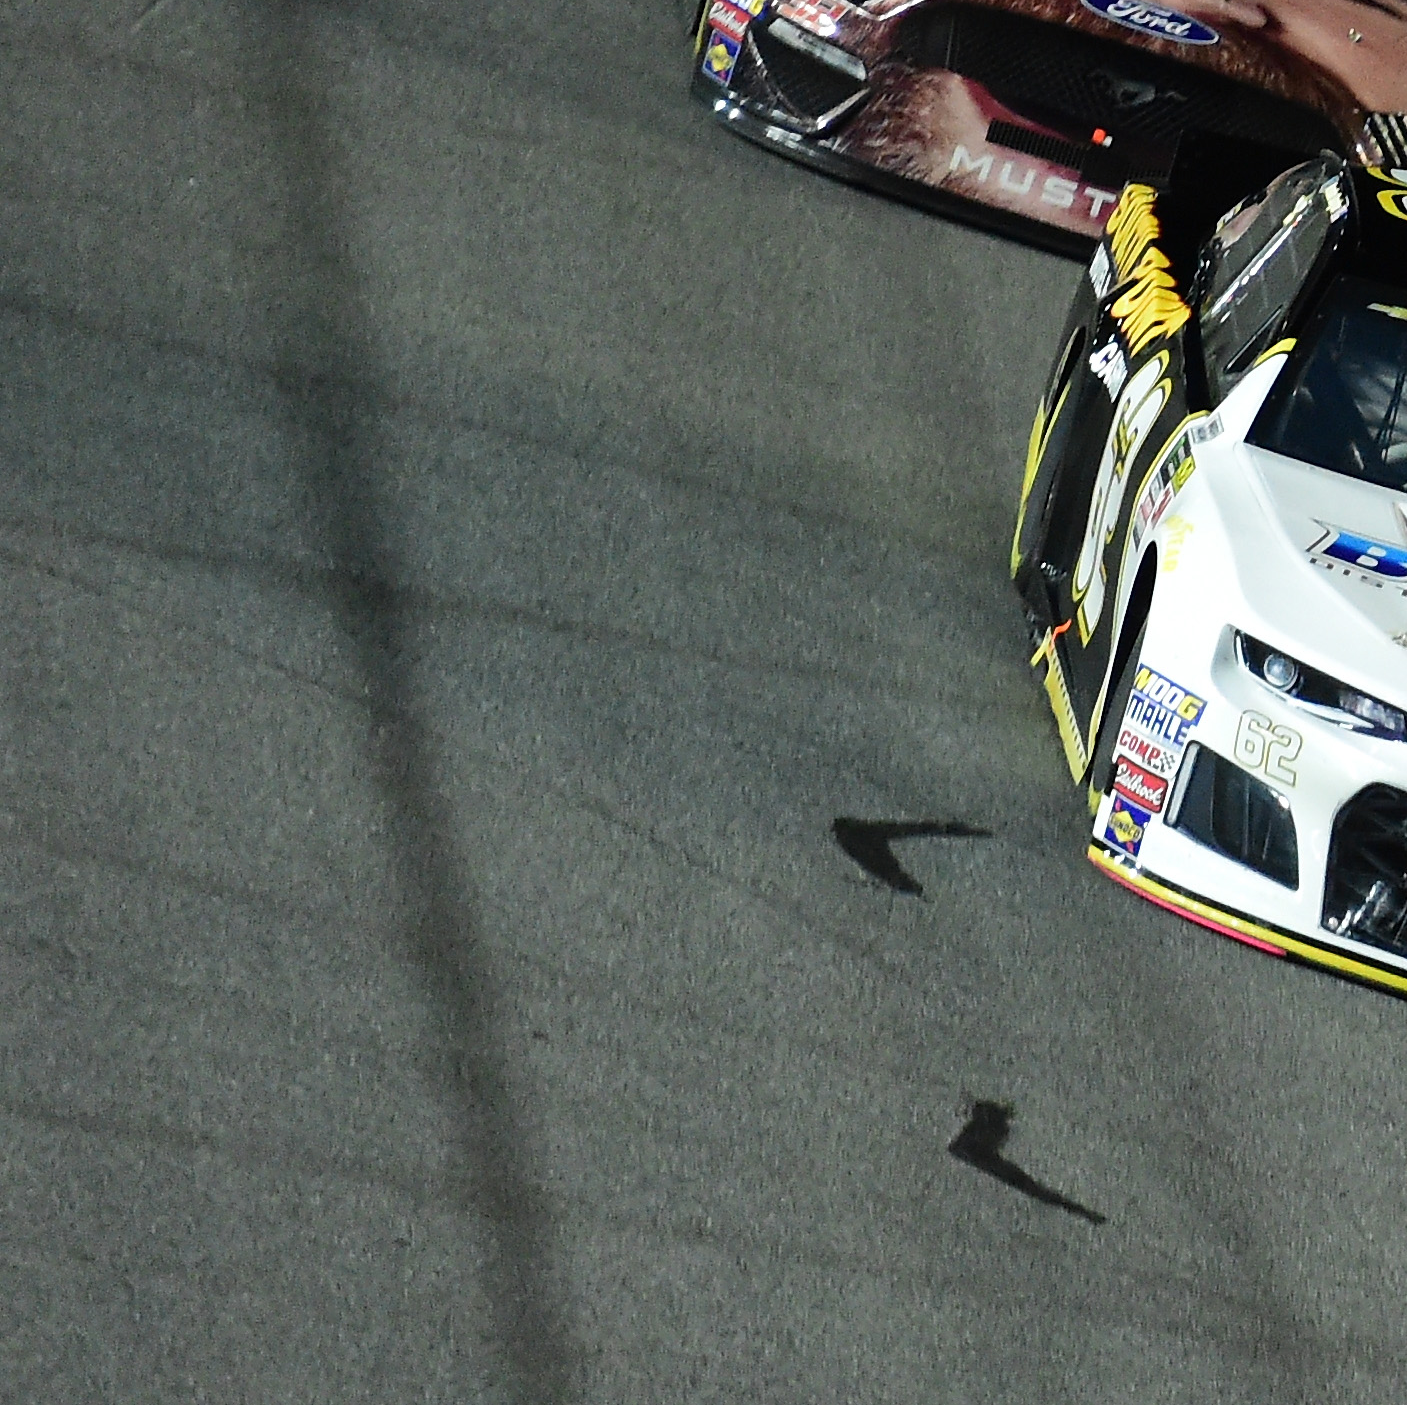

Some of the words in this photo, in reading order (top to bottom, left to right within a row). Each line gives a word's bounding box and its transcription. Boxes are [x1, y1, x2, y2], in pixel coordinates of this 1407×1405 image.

[950, 146, 1117, 217] MUST
[1134, 667, 1203, 721] MOOG
[1119, 730, 1162, 766] COMP
[1127, 697, 1191, 746] MAHLE
[1234, 709, 1303, 787] 62
